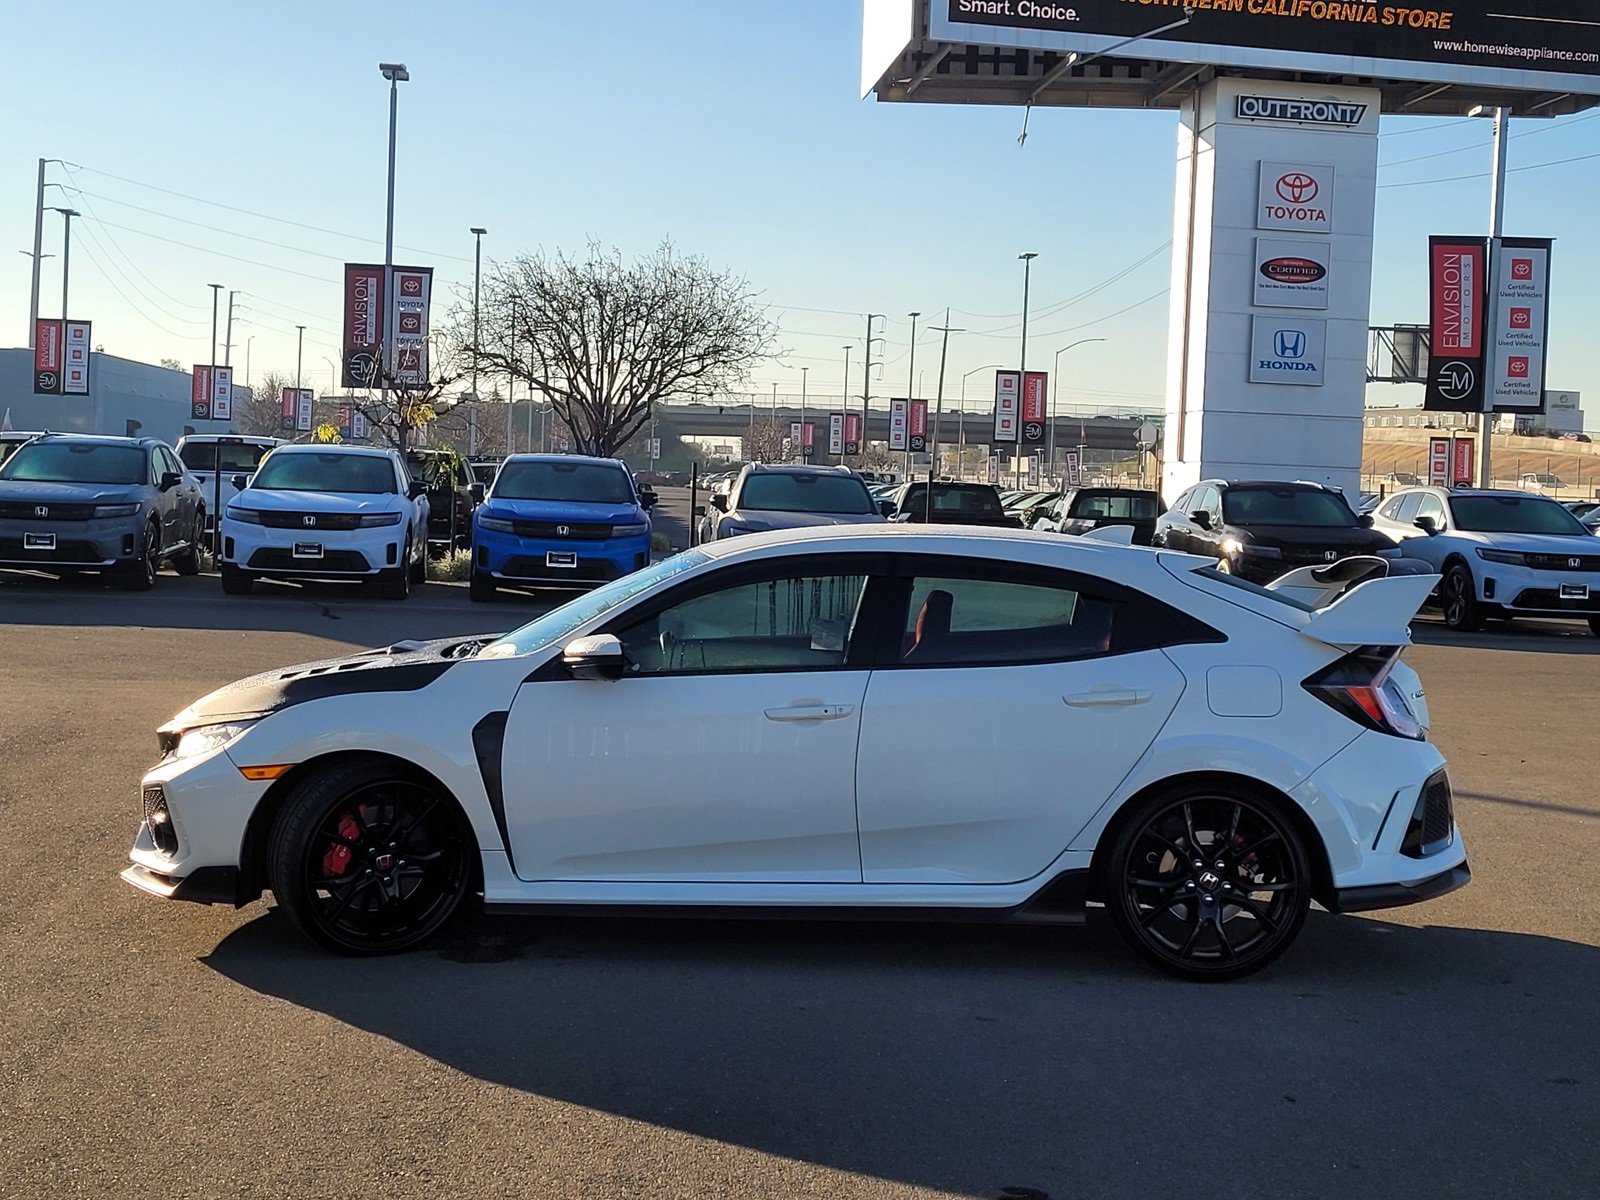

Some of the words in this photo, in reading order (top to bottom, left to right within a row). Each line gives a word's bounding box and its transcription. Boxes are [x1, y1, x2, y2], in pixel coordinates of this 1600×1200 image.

[959, 0, 1014, 15] Smart.
[1017, 1, 1080, 21] Choice.
[1247, 0, 1378, 23] CALIFORNIA
[1381, 7, 1453, 29] STORE
[1433, 40, 1599, 62] www.homewiseappliance.com
[1265, 206, 1326, 222] TOYOTA
[1268, 265, 1318, 275] CERTIFIED
[354, 277, 367, 344] ENVISION
[1443, 254, 1459, 348] ENVISION
[1463, 263, 1471, 340] MOTORS
[41, 326, 49, 367] ENVISION
[1259, 360, 1317, 371] HONDA
[1028, 378, 1036, 418] ENVISION
